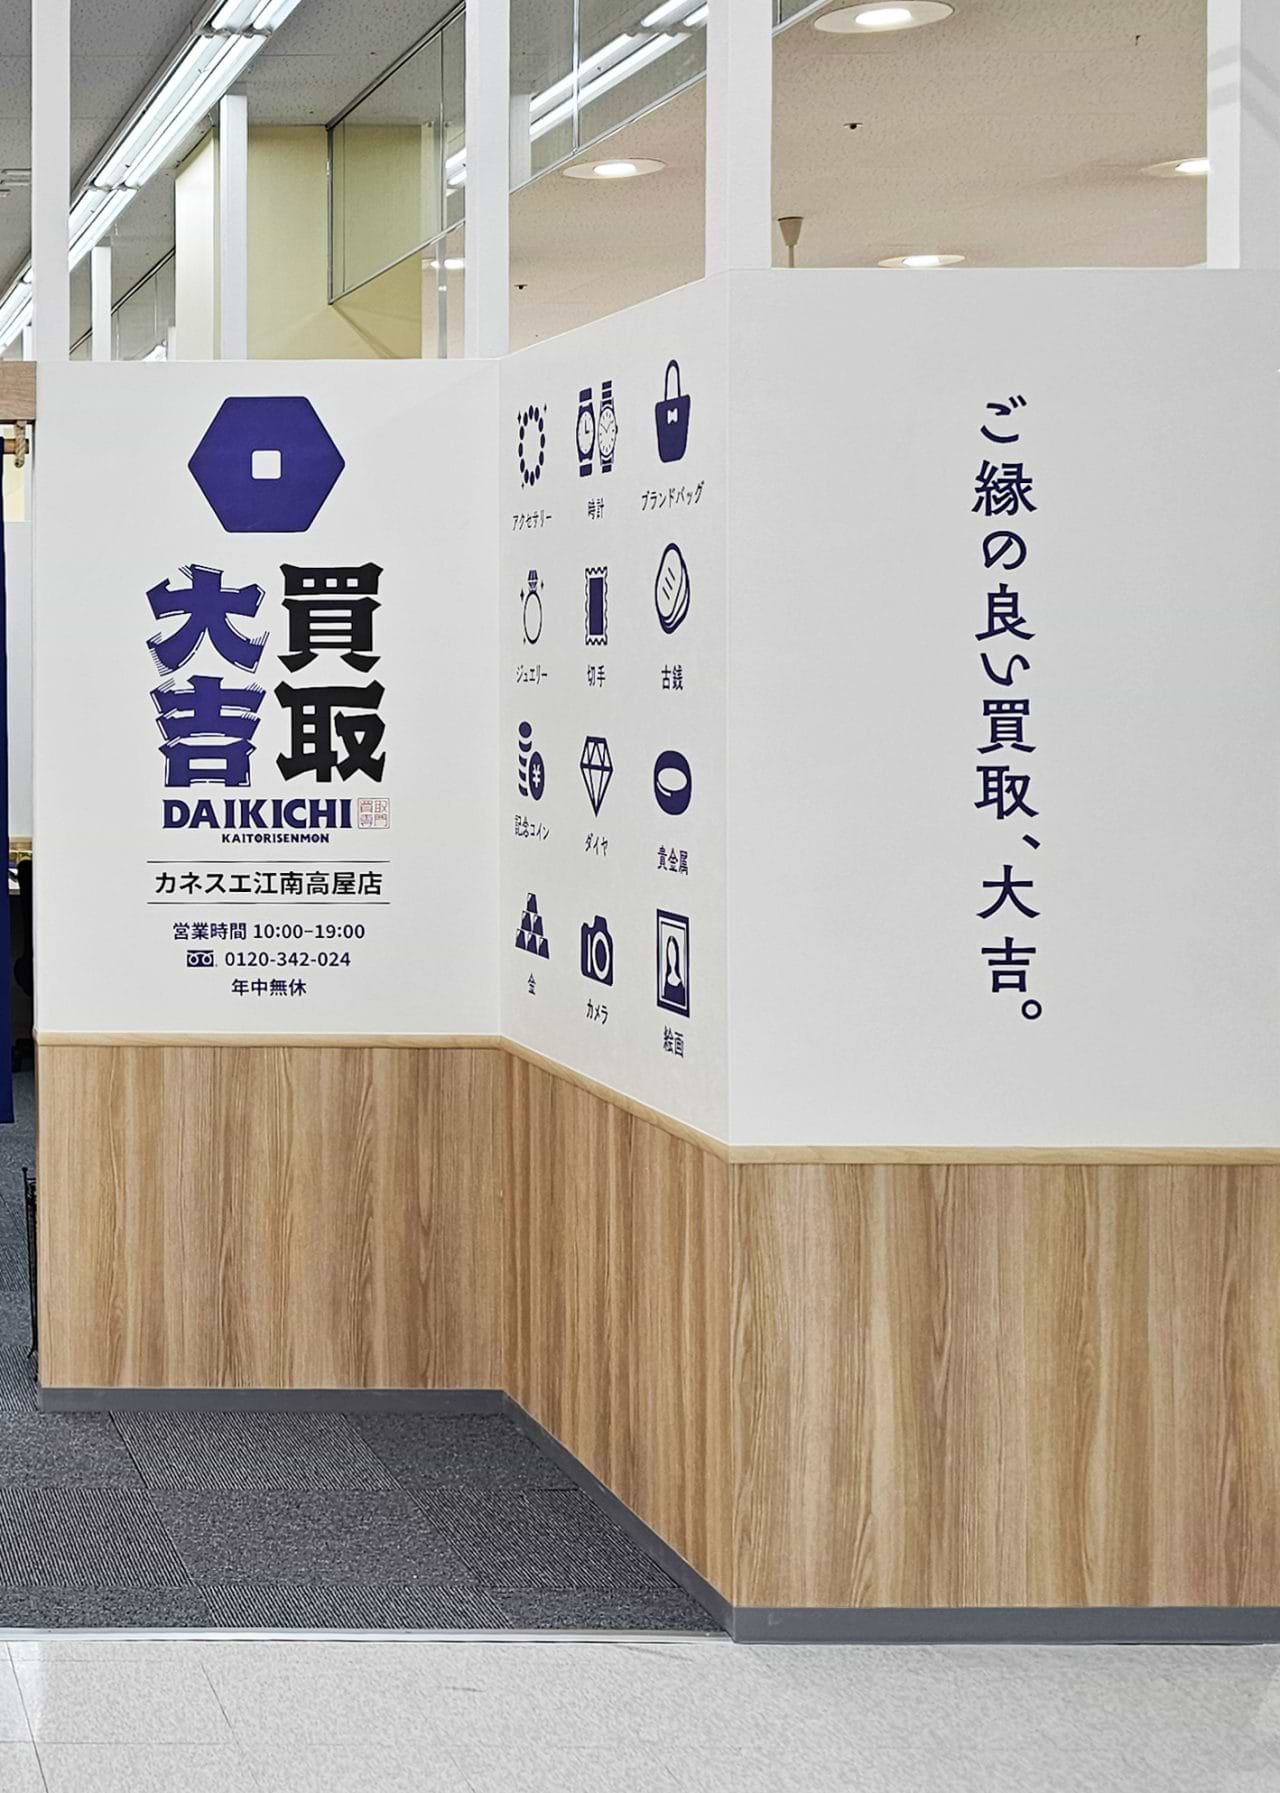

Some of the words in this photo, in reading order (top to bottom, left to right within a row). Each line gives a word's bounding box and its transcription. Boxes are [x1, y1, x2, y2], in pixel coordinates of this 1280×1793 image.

[642, 480, 704, 511] ブランドバッグ
[588, 498, 604, 520] 時計
[146, 564, 270, 788] 大吉
[274, 562, 386, 783] 買取
[517, 664, 547, 685] ジュエリー
[587, 665, 606, 687] 切手
[971, 395, 1042, 1020] ご縁の良い買取、大吉。
[162, 799, 352, 829] DAIKICHI
[585, 833, 608, 856] ダイヤ
[657, 845, 688, 875] 貴金属
[155, 871, 383, 895] カネスエ江南高屋店
[173, 922, 247, 940] 営業時間
[225, 952, 351, 967] 0120-342-024
[231, 978, 307, 997] 年中無休
[528, 973, 536, 995] 金
[586, 998, 608, 1024] カメラ
[663, 1025, 684, 1058] 絵画
